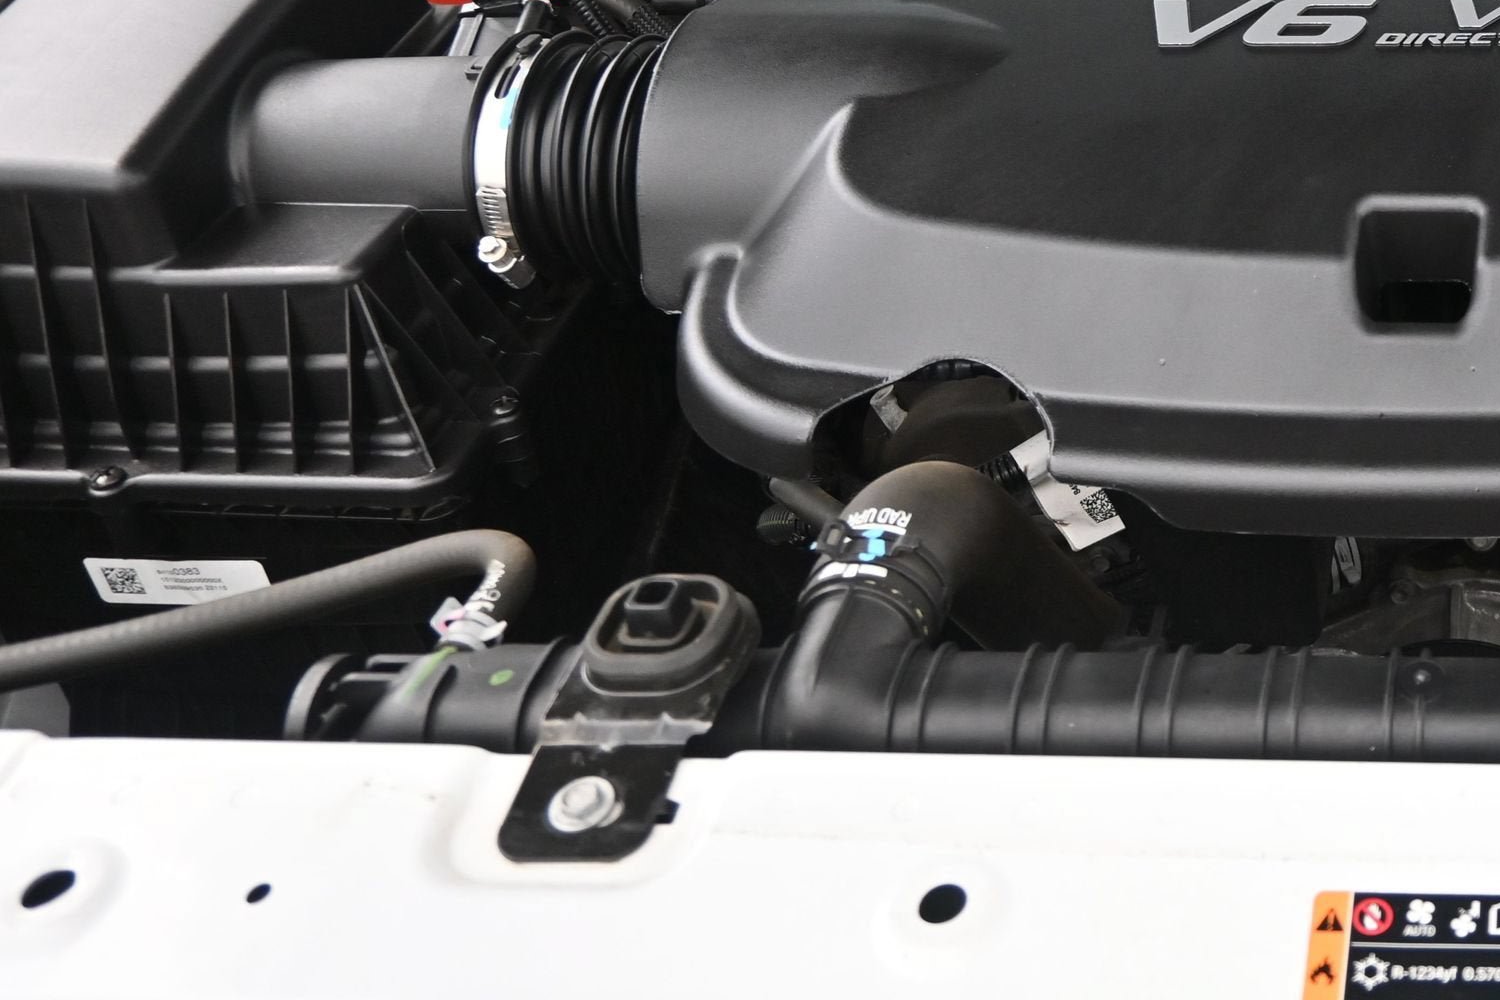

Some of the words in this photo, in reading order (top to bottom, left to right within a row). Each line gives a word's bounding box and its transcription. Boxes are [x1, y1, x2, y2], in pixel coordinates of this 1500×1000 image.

[876, 507, 913, 528] RAD
[1402, 924, 1437, 938] AUTO
[1390, 964, 1458, 984] R-1234yf
